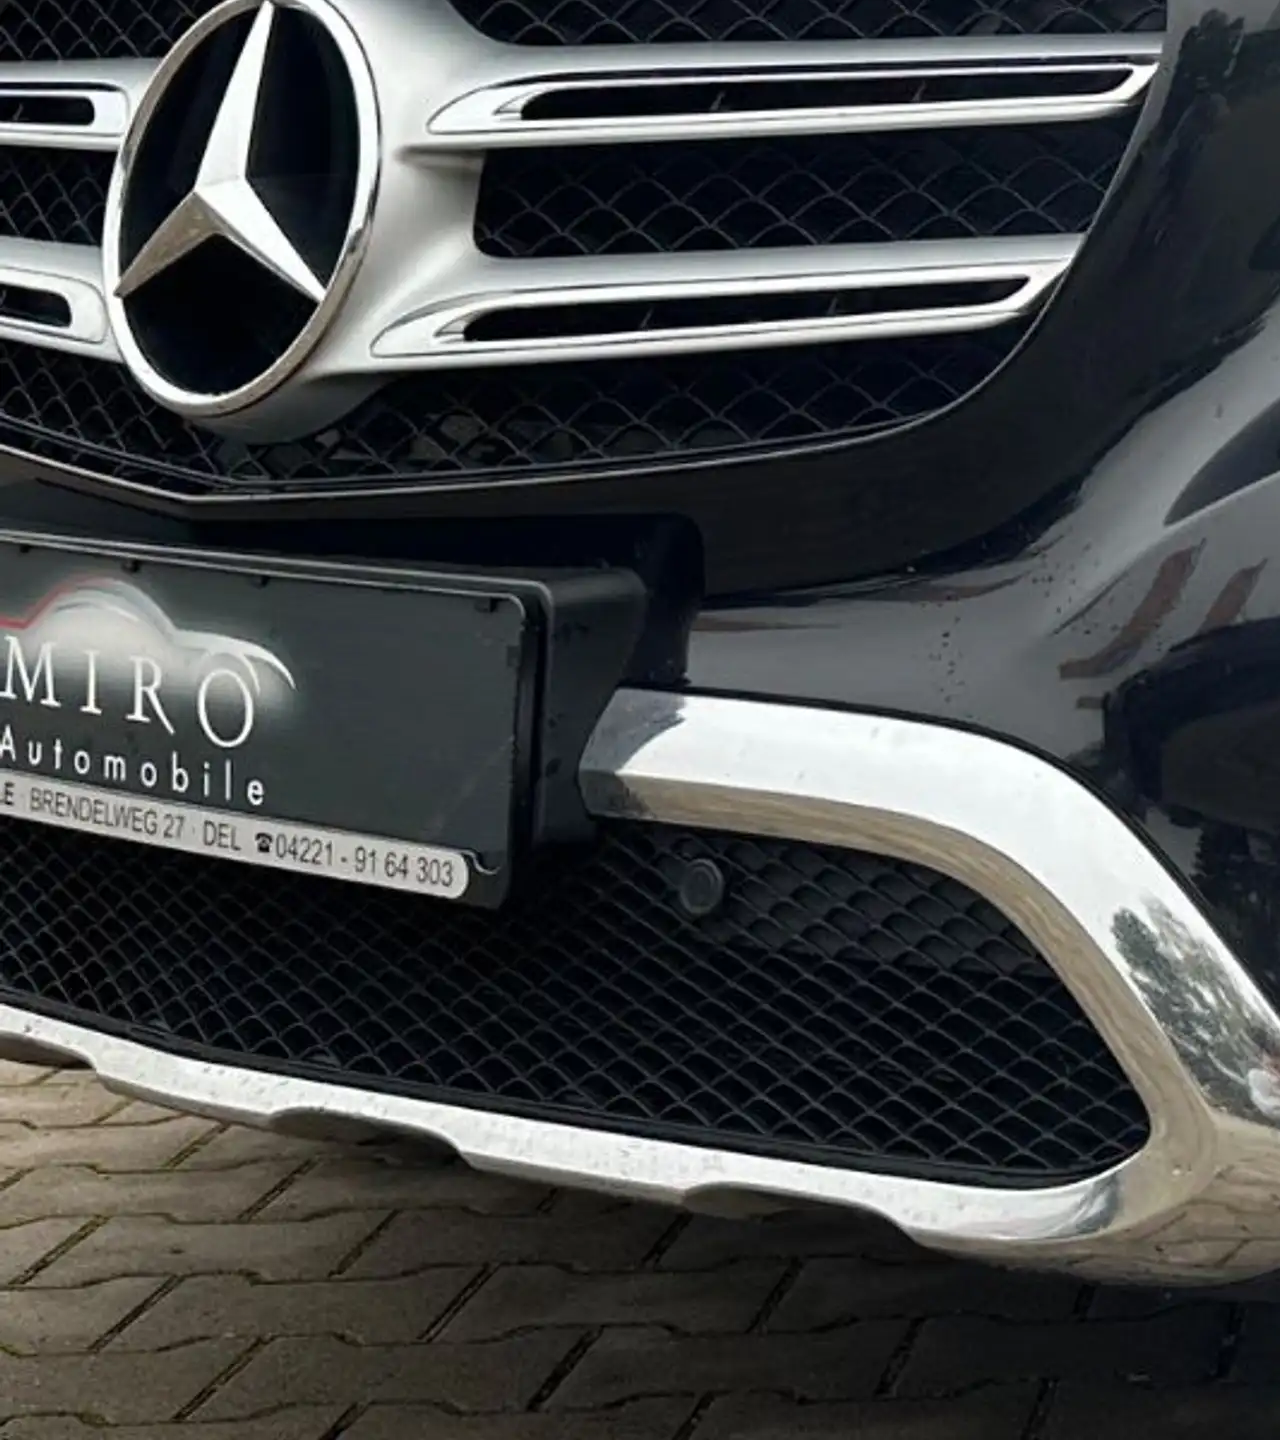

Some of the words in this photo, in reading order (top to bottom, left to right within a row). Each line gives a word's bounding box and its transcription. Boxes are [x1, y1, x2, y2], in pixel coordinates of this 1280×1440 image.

[0, 635, 255, 749] MIRO
[0, 723, 266, 806] Automobile
[30, 786, 158, 836] BRENDELWEG
[163, 812, 185, 838] 27
[202, 819, 242, 852] DEL
[275, 833, 334, 867] 04221
[354, 846, 377, 874] 91
[384, 851, 409, 879] 64
[415, 856, 454, 888] 303
